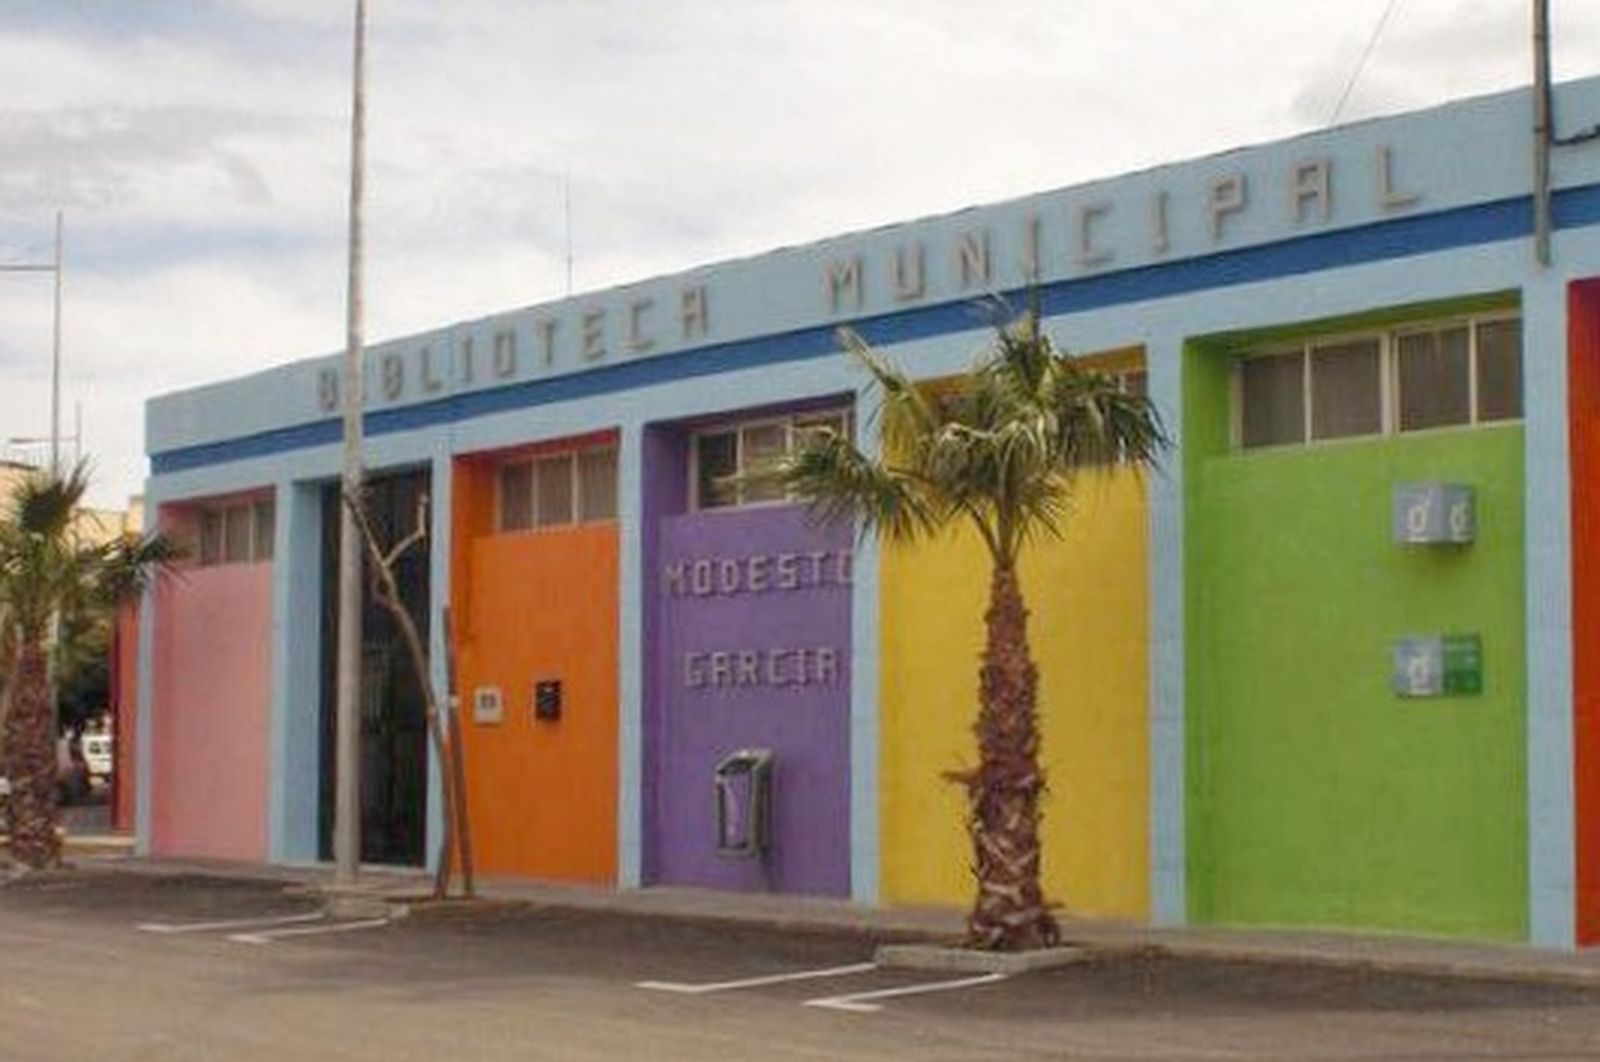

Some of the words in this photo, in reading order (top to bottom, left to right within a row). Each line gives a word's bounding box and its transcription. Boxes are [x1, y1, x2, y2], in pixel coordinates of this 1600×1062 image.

[316, 286, 709, 413] BBLIOTECA
[822, 144, 1424, 313] MUNICIPAL
[684, 648, 838, 687] GARCIA
